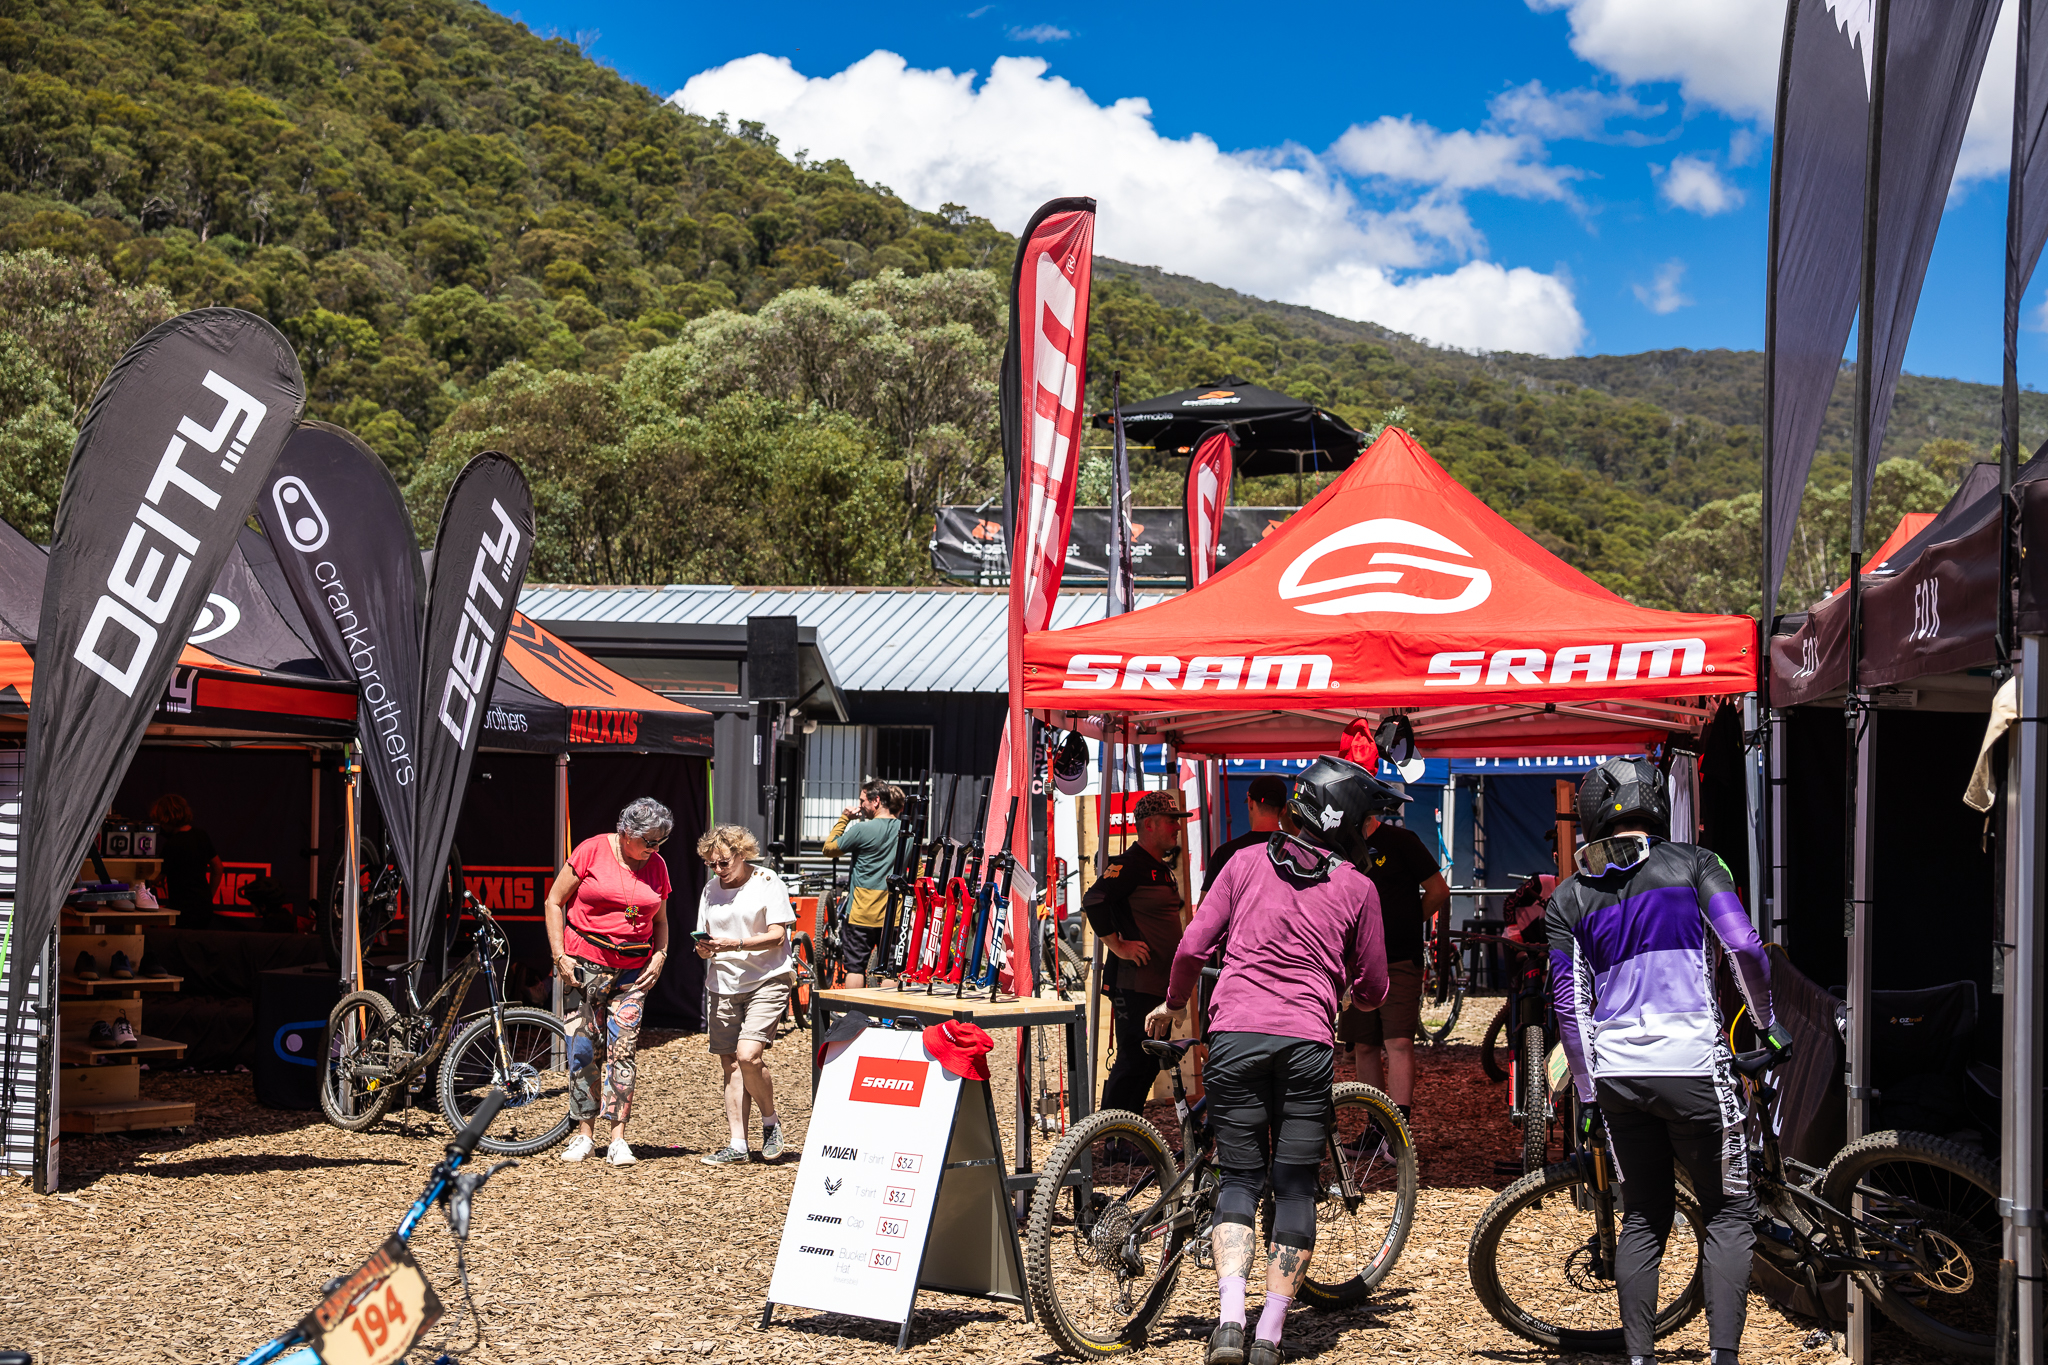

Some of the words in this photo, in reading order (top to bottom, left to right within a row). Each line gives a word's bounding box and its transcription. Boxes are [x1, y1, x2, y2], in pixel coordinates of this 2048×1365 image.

[1121, 412, 1174, 422] oostmobile
[74, 369, 267, 698] DEITY
[438, 497, 521, 751] DEITY
[314, 560, 416, 787] crankbrothers
[1063, 653, 1333, 691] SRAM
[1424, 638, 1707, 686] SRAM
[569, 709, 639, 744] MAXXIS
[895, 907, 911, 966] BOXXER
[924, 918, 941, 969] ZEB
[861, 1077, 914, 1091] SRAM
[1372, 1099, 1401, 1127] PIRELLI
[1114, 1124, 1149, 1137] PIRELLI
[822, 1145, 858, 1161] MAVEN
[897, 1156, 914, 1169] $32
[889, 1190, 906, 1203] $32
[807, 1214, 842, 1225] SRAM
[847, 1216, 864, 1230] Cap
[882, 1220, 899, 1235] $30
[799, 1245, 835, 1257] SRAM
[839, 1248, 867, 1262] Bucket
[874, 1253, 892, 1267] $30
[836, 1262, 850, 1274] Hat
[352, 1285, 407, 1357] 194
